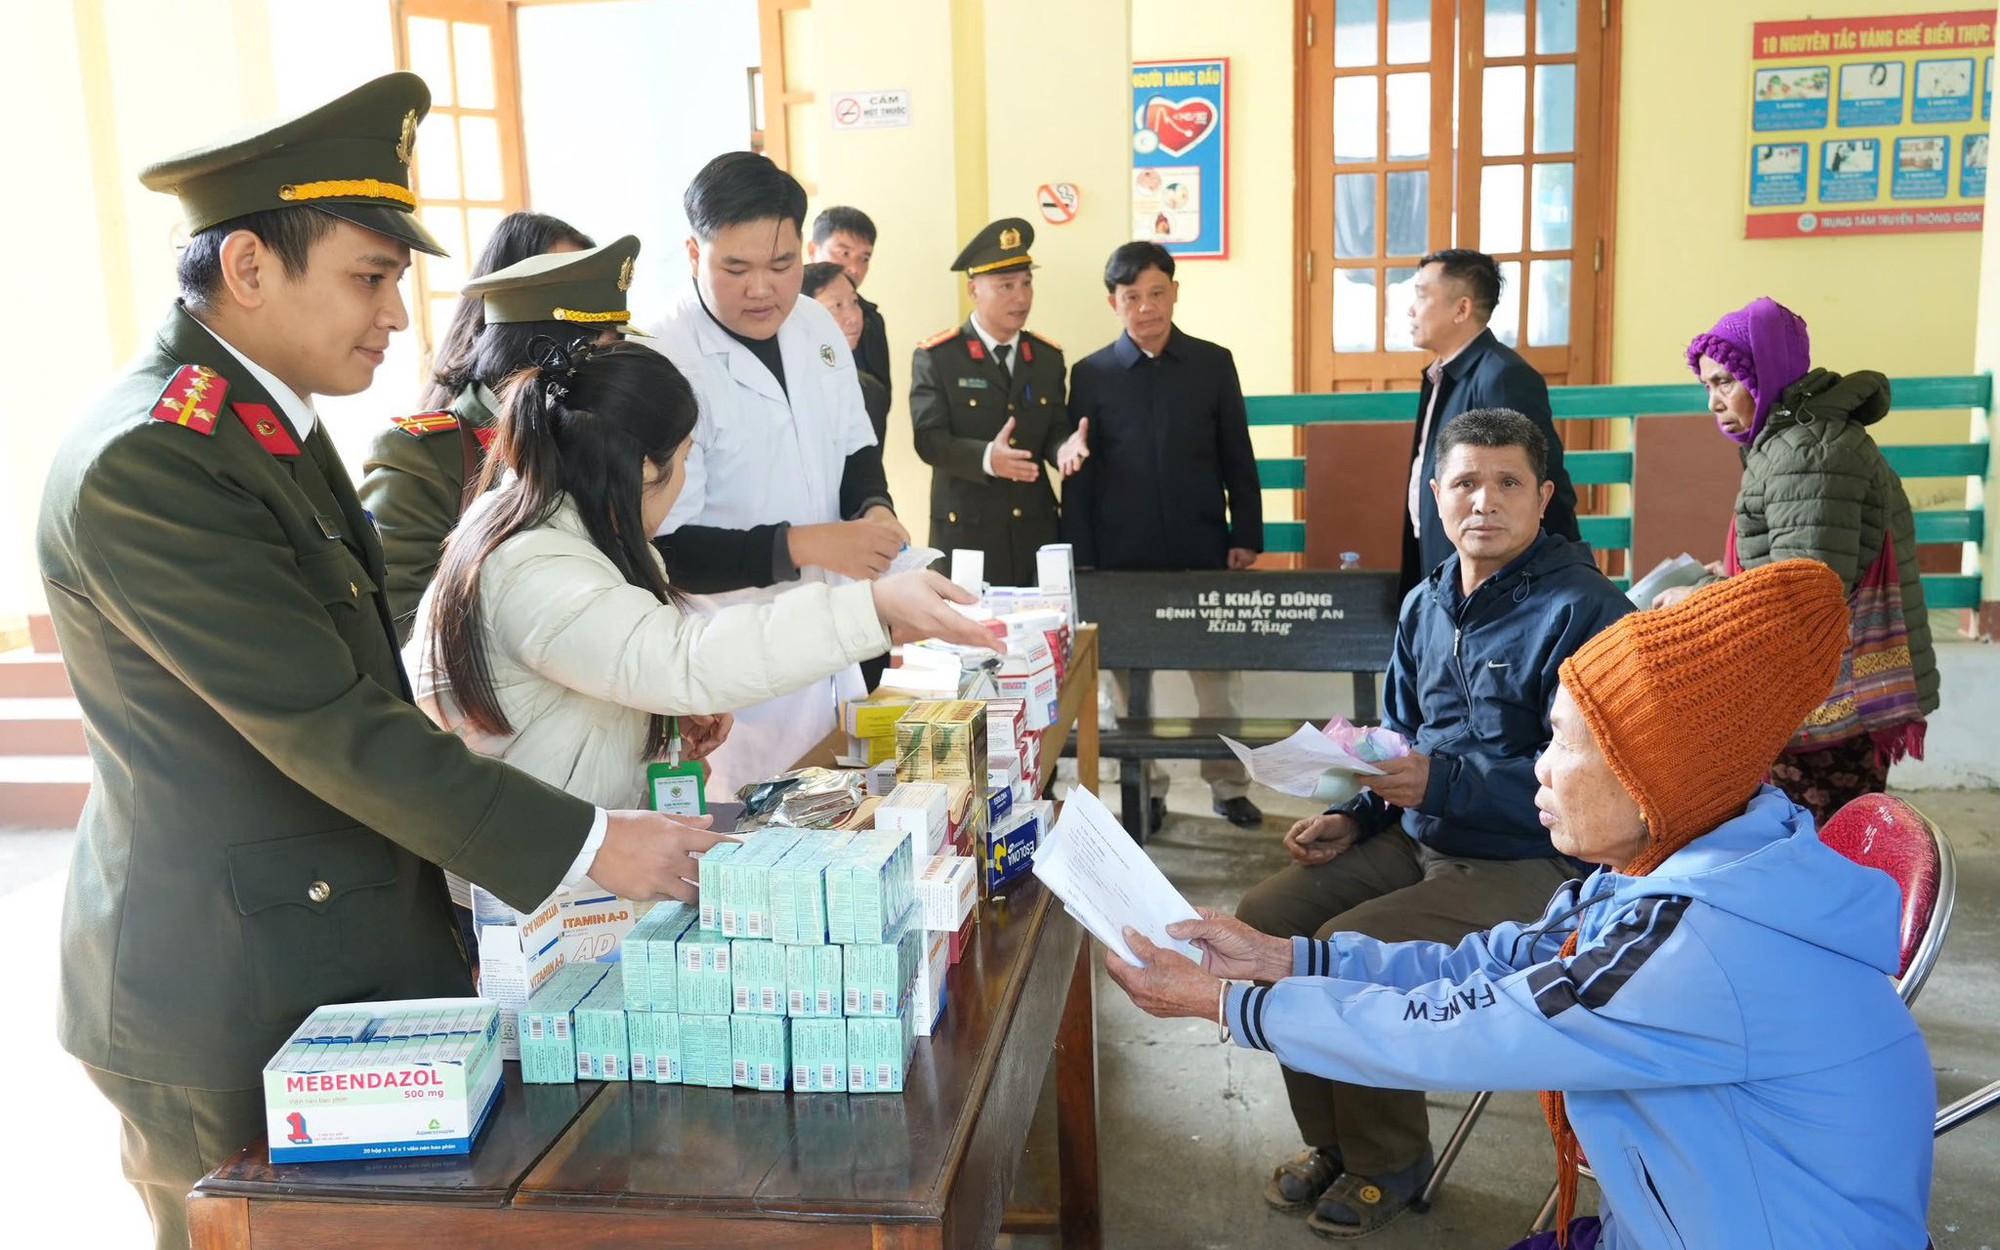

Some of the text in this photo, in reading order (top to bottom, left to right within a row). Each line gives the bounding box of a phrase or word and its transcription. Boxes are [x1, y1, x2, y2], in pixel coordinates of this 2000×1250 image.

[1762, 37, 1777, 53] 10
[1779, 30, 1830, 52] NGUYÊN
[1833, 28, 1857, 49] TẮC
[1859, 27, 1893, 48] VÀNG
[1896, 23, 1923, 46] CHẾ
[1924, 22, 1954, 45] BIẾN
[1165, 69, 1196, 87] HÀNG
[1198, 590, 1220, 606] LÊ
[1225, 590, 1275, 607] KHẮC
[1155, 606, 1196, 621] BỆNH
[1200, 606, 1234, 620] VIỆN
[1275, 606, 1318, 621] NGHỆ
[1321, 609, 1344, 619] AN
[1207, 619, 1292, 636] Kính Tặng
[1007, 840, 1035, 867] ESOLONA
[607, 910, 629, 923] A-D
[572, 933, 617, 963] AD
[1403, 983, 1497, 1022] FANEW
[287, 1070, 443, 1093] MEBENDAZOL
[404, 1090, 444, 1099] 500 mg
[286, 1112, 309, 1141] 1
